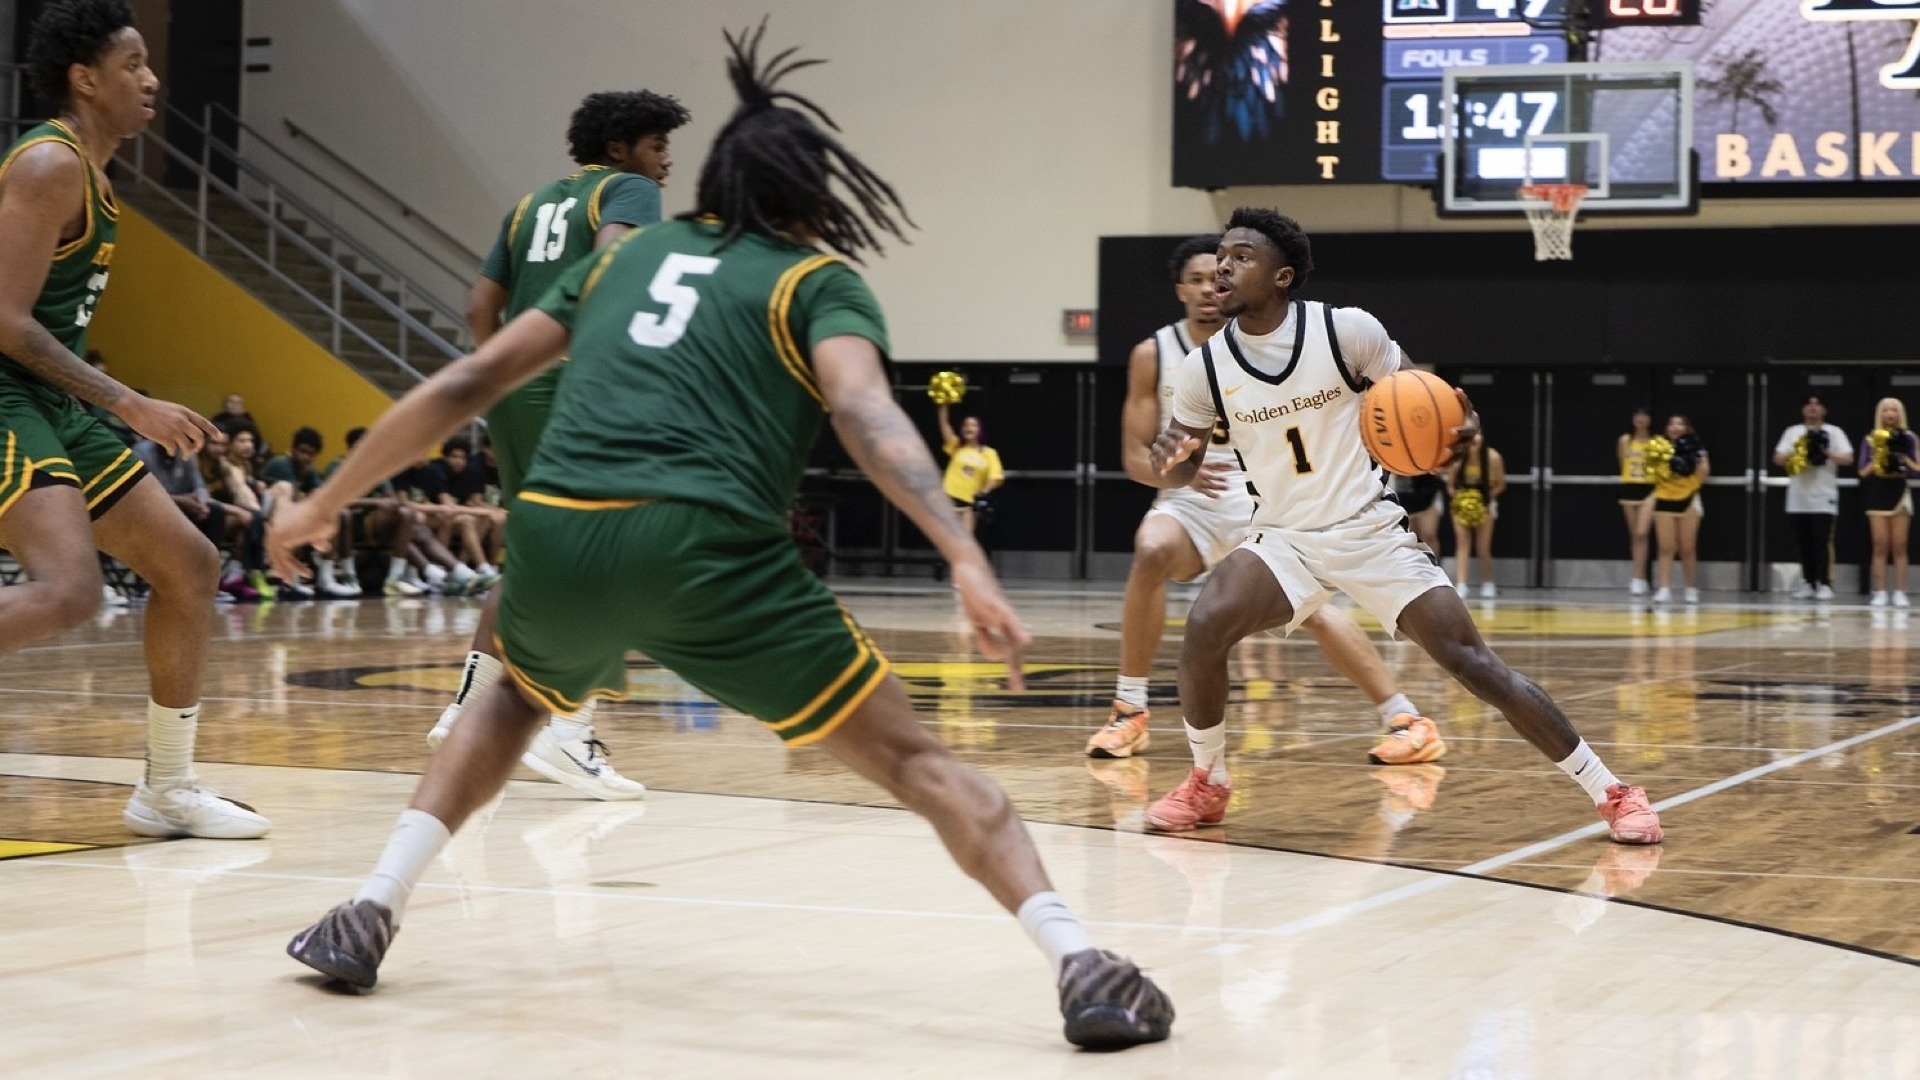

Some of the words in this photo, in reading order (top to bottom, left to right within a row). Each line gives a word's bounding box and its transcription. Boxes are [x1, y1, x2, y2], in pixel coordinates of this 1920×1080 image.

[1402, 48, 1489, 68] FOULS
[1529, 43, 1550, 65] 2
[1315, 0, 1341, 180] LIGHT
[1716, 131, 1920, 178] BASK
[526, 197, 578, 262] 15
[628, 252, 722, 348] 5
[1234, 406, 1290, 424] Golden
[1291, 386, 1342, 413] Eagles
[1284, 426, 1314, 475] 1
